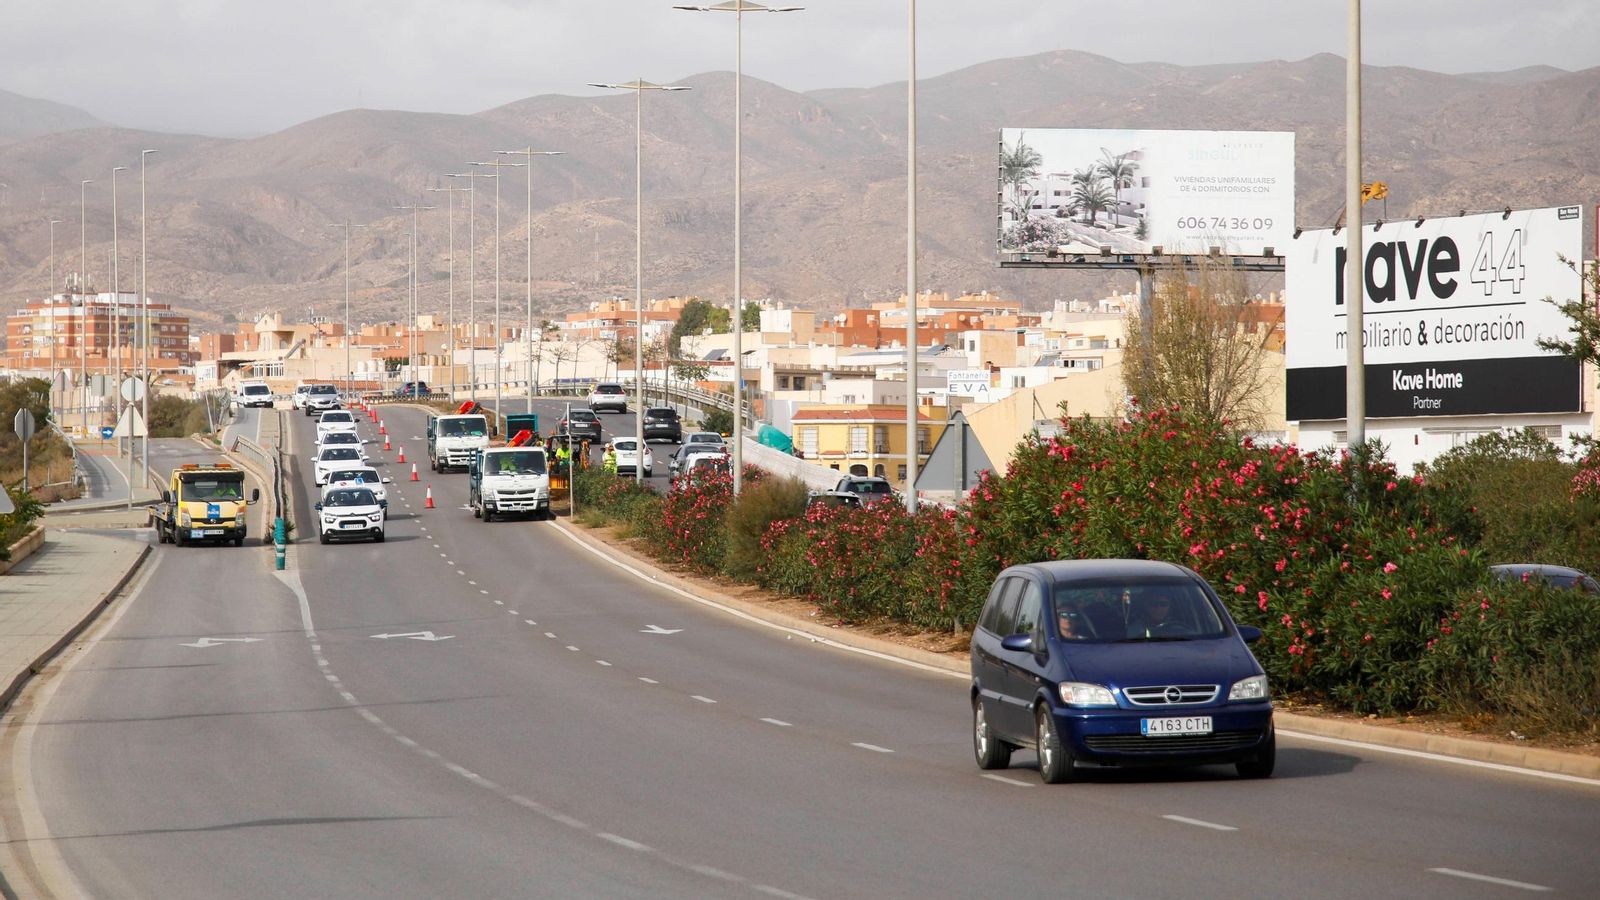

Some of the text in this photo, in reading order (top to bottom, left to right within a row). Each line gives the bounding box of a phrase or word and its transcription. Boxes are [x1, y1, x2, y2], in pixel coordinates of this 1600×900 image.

[1174, 176, 1276, 184] VIVIENDAS UNIFAMILIARES
[1198, 185, 1251, 193] DORMITORIOS
[1177, 217, 1273, 230] 606 74 36 09
[1470, 229, 1526, 296] 44
[1417, 320, 1428, 346] &
[1434, 313, 1525, 343] decoración
[1392, 369, 1463, 391] Kave Home
[1413, 396, 1442, 409] Partner
[1150, 717, 1211, 733] 4163 CTH
